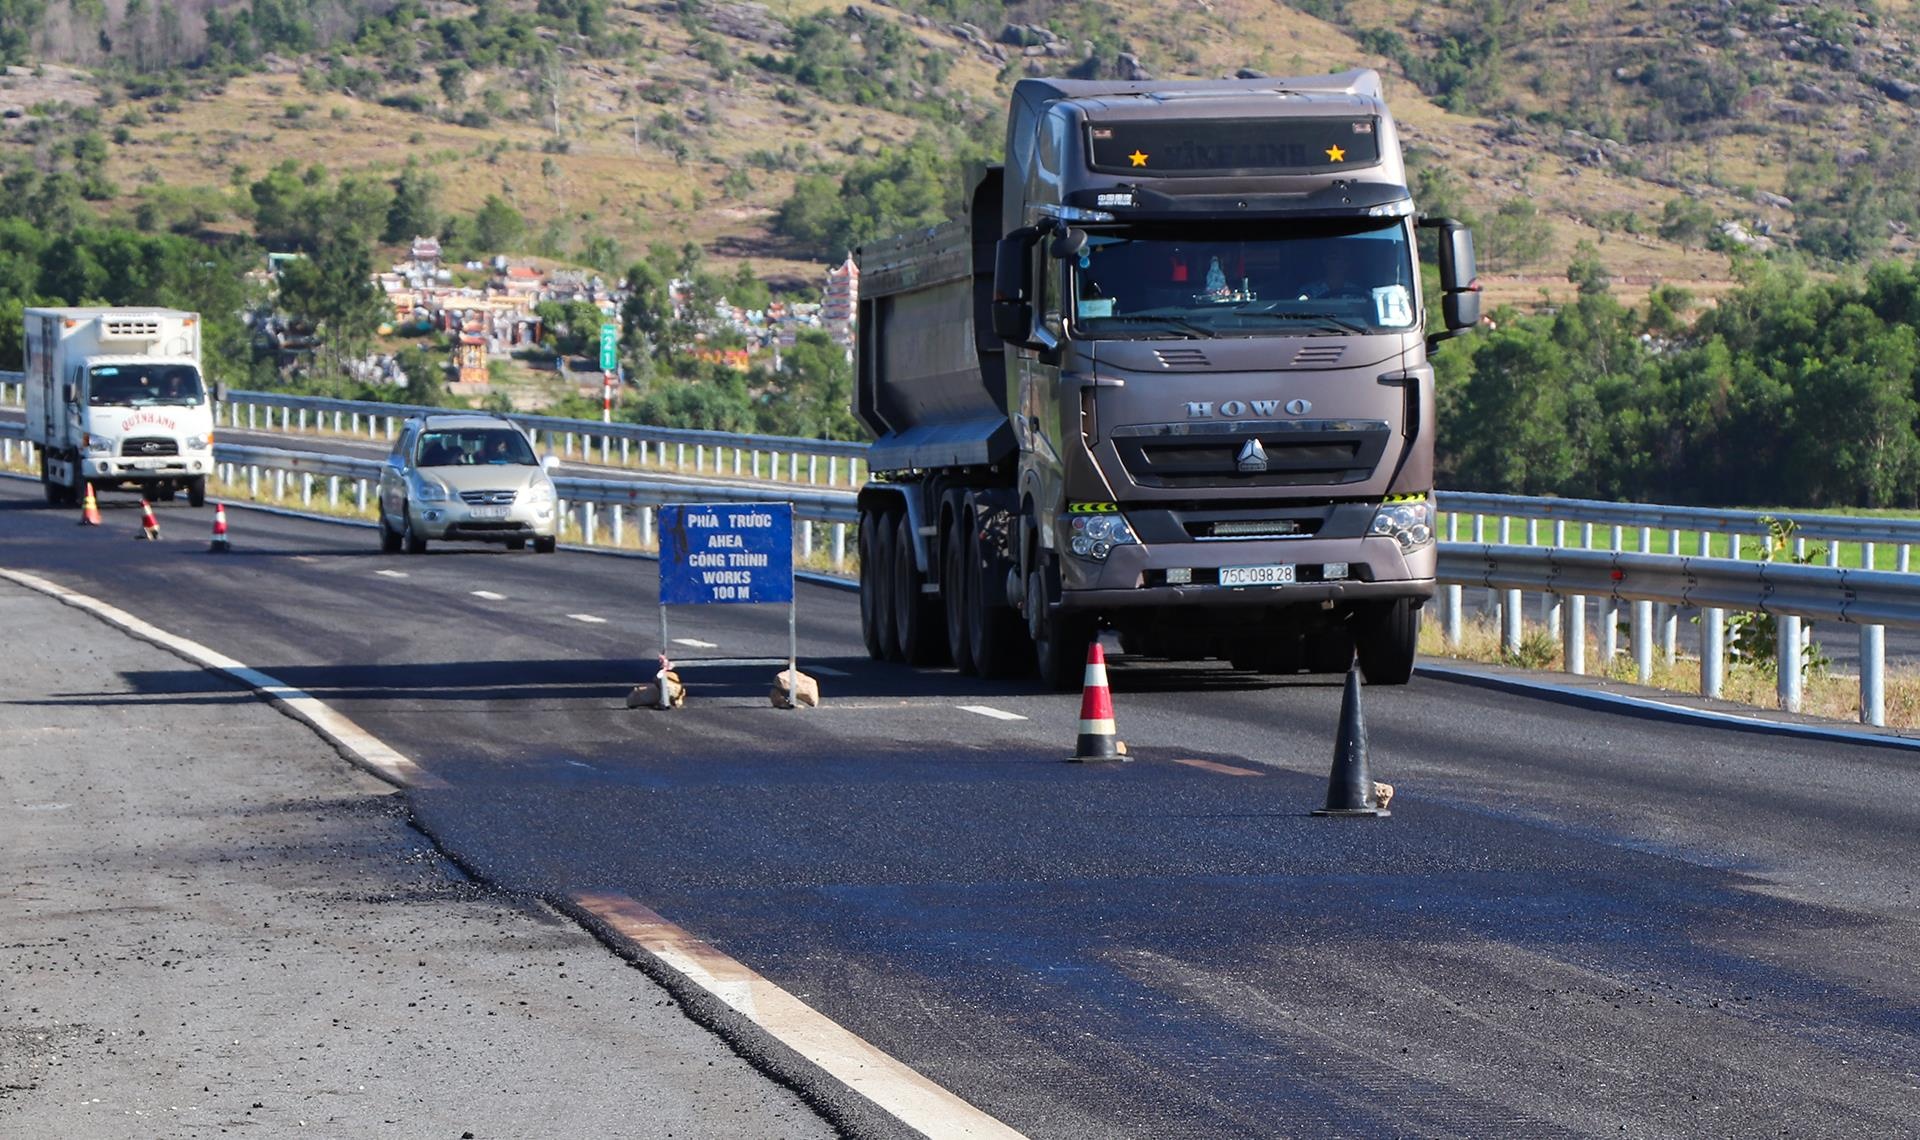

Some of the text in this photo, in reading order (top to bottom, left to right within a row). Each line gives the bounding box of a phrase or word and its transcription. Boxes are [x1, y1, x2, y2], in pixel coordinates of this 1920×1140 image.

[1187, 398, 1312, 417] HOWO
[156, 415, 176, 430] ANH
[708, 535, 743, 548] AHEA
[689, 549, 768, 567] CÔNG TRÌNH
[703, 571, 751, 584] WORKS
[712, 586, 750, 600] 100 M
